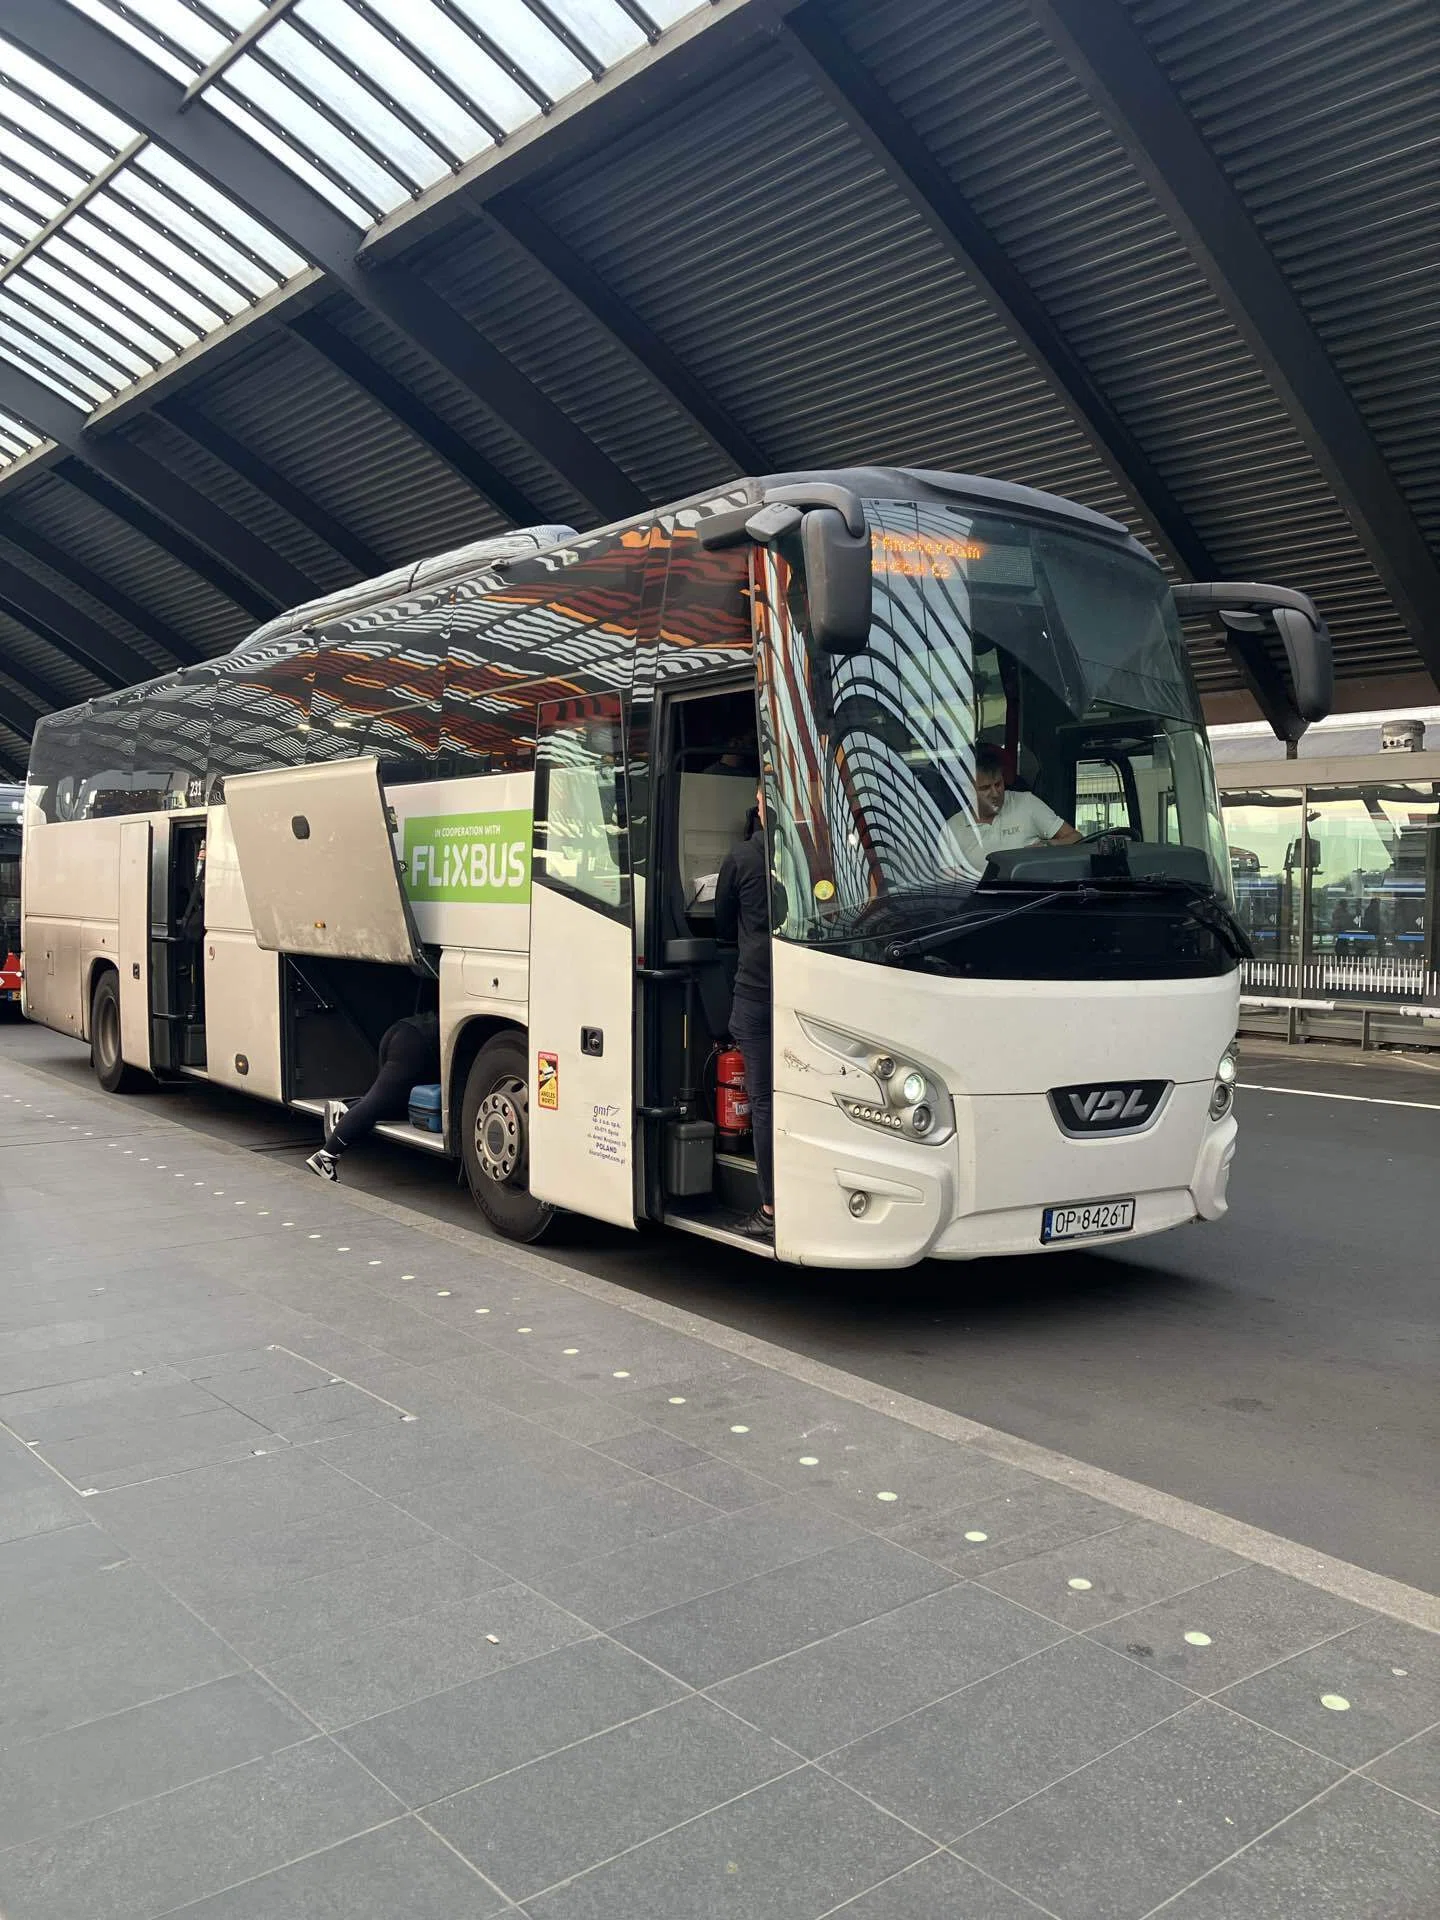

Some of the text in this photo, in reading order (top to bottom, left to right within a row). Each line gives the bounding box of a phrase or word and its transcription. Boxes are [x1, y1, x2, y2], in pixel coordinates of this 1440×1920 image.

[190, 780, 202, 797] 231
[441, 825, 483, 838] COOPERATION
[484, 824, 501, 836] WITH
[1068, 1088, 1149, 1122] VDL
[596, 1142, 617, 1154] POLAND
[1082, 1204, 1129, 1229] 8426T
